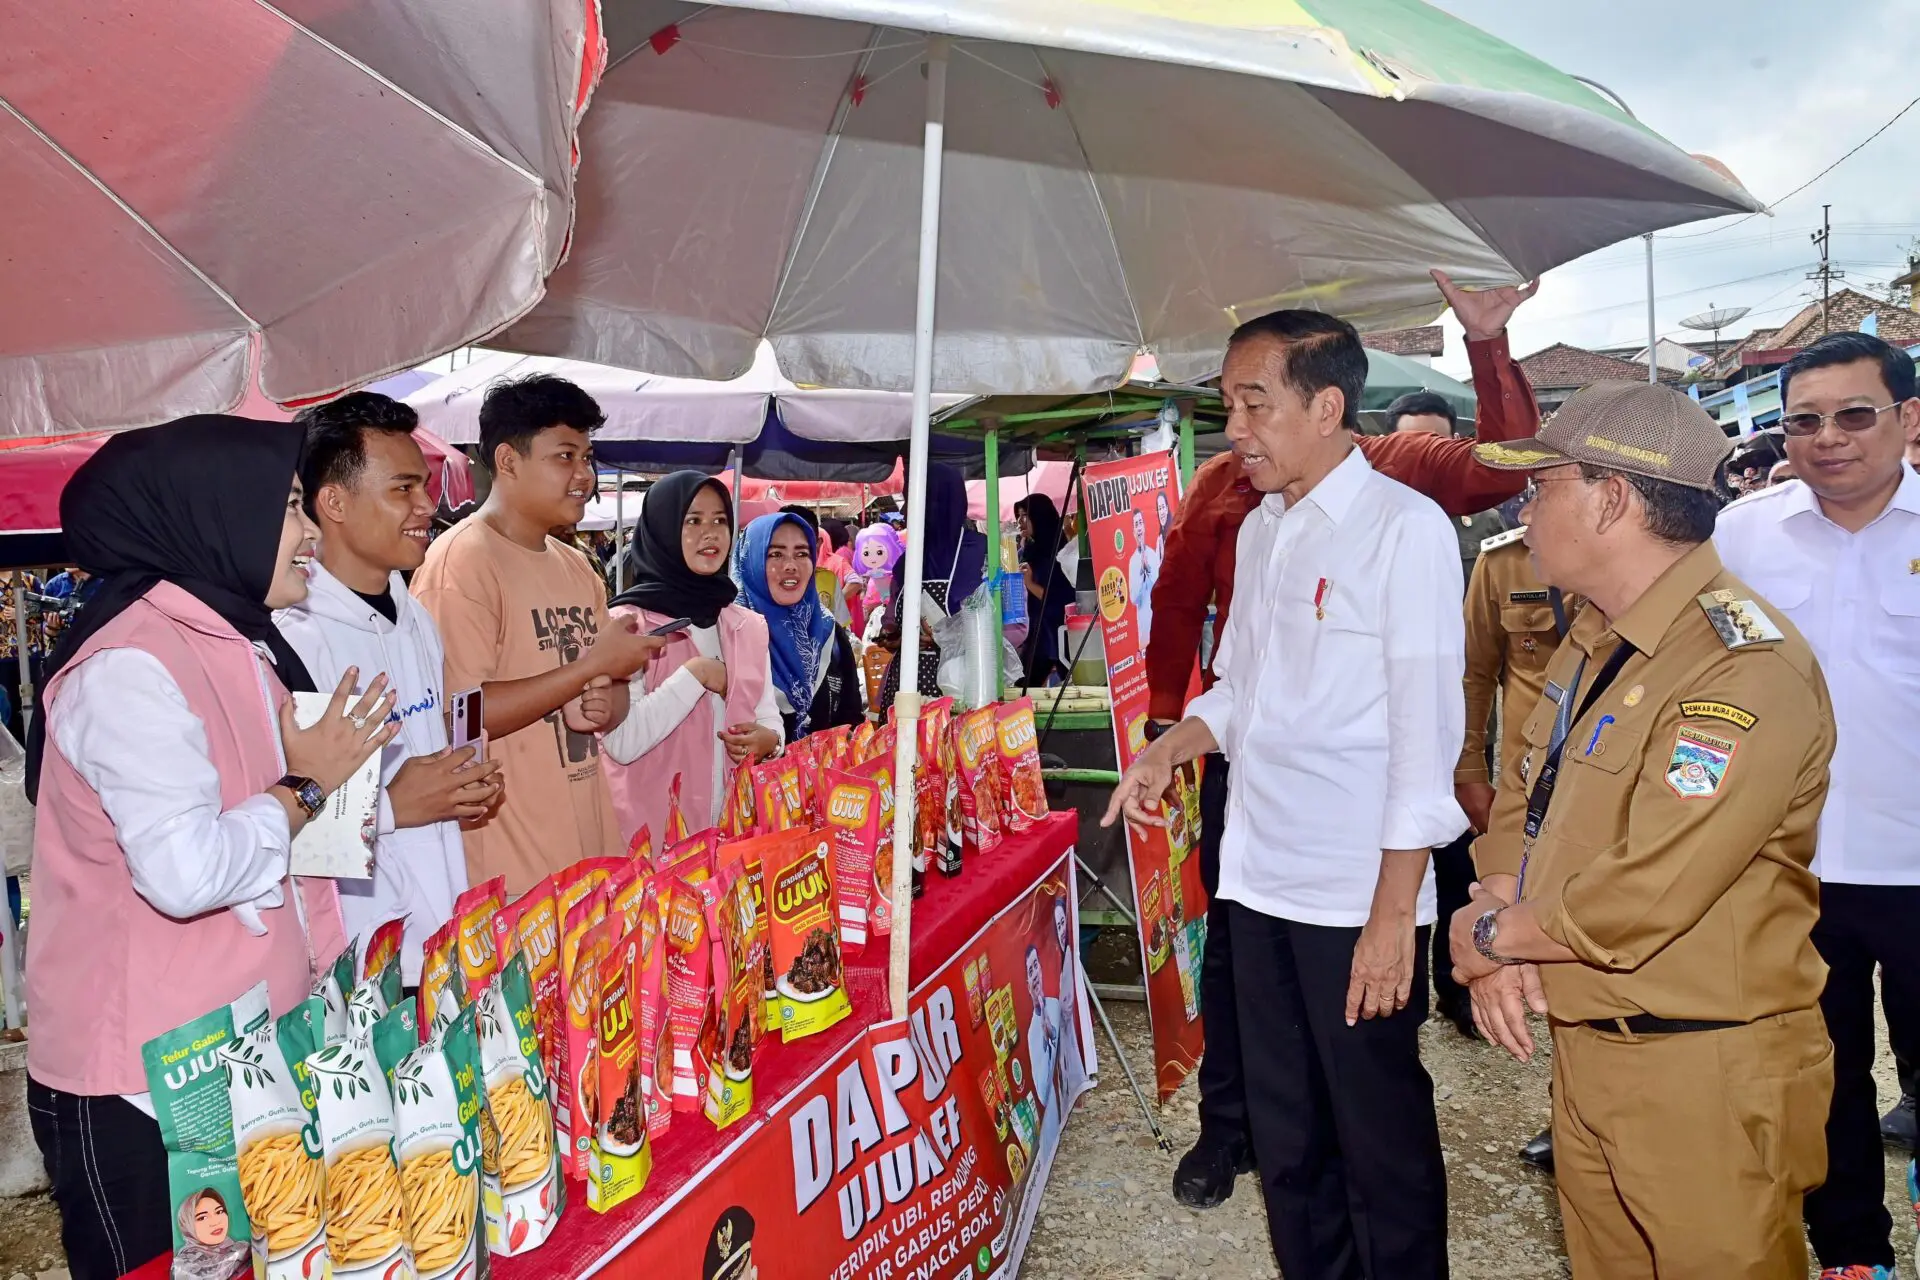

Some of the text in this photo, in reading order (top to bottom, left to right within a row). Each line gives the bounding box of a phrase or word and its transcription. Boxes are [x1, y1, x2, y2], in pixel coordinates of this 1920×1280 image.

[1585, 435, 1669, 466] BUPATI MURATARA
[1087, 468, 1168, 521] DAPUR UJUK EF
[1685, 705, 1752, 725] PEMKAB MURA UTARA
[1004, 721, 1036, 750] UJUK
[832, 799, 864, 821] UJUK
[778, 870, 828, 913] UJUK
[671, 914, 699, 944] UJUK
[161, 1029, 227, 1066] Telur Gabus
[789, 984, 962, 1214] DAPUR
[838, 1096, 961, 1239] UJUK EF
[830, 1224, 890, 1280] KERIPIK
[892, 1203, 927, 1236] UBI,
[930, 1145, 978, 1211] RENDANG,
[894, 1212, 956, 1268] GABUS,
[958, 1176, 989, 1219] PEDO,
[961, 1208, 992, 1248] BOX,
